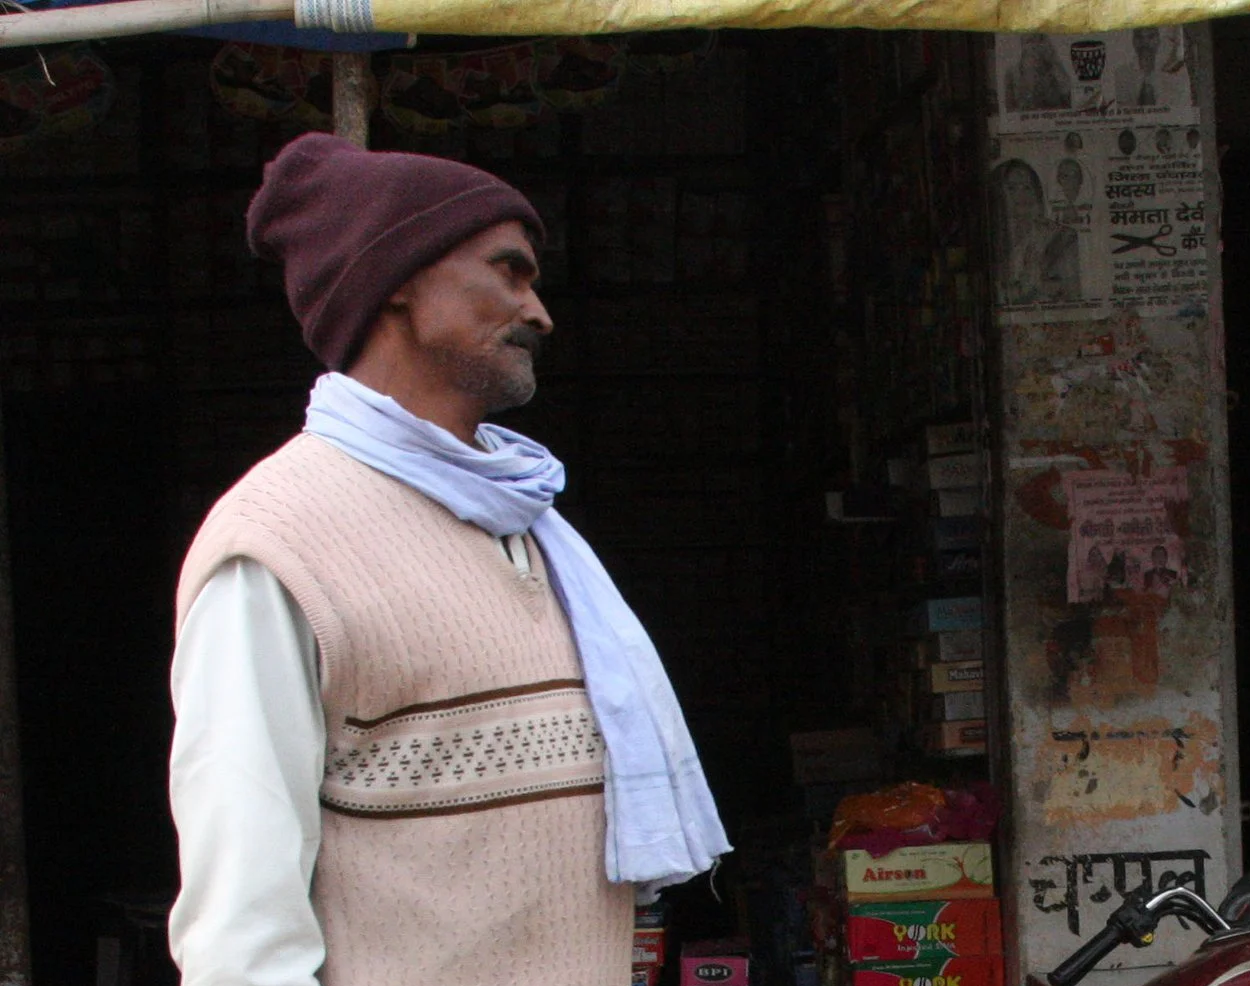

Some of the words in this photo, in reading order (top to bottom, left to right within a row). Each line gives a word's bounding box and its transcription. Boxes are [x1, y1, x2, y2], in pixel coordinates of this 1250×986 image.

[1104, 184, 1156, 199] सदस्य
[1109, 208, 1170, 225] ममता
[893, 923, 956, 943] YORK
[698, 967, 728, 977] BPI
